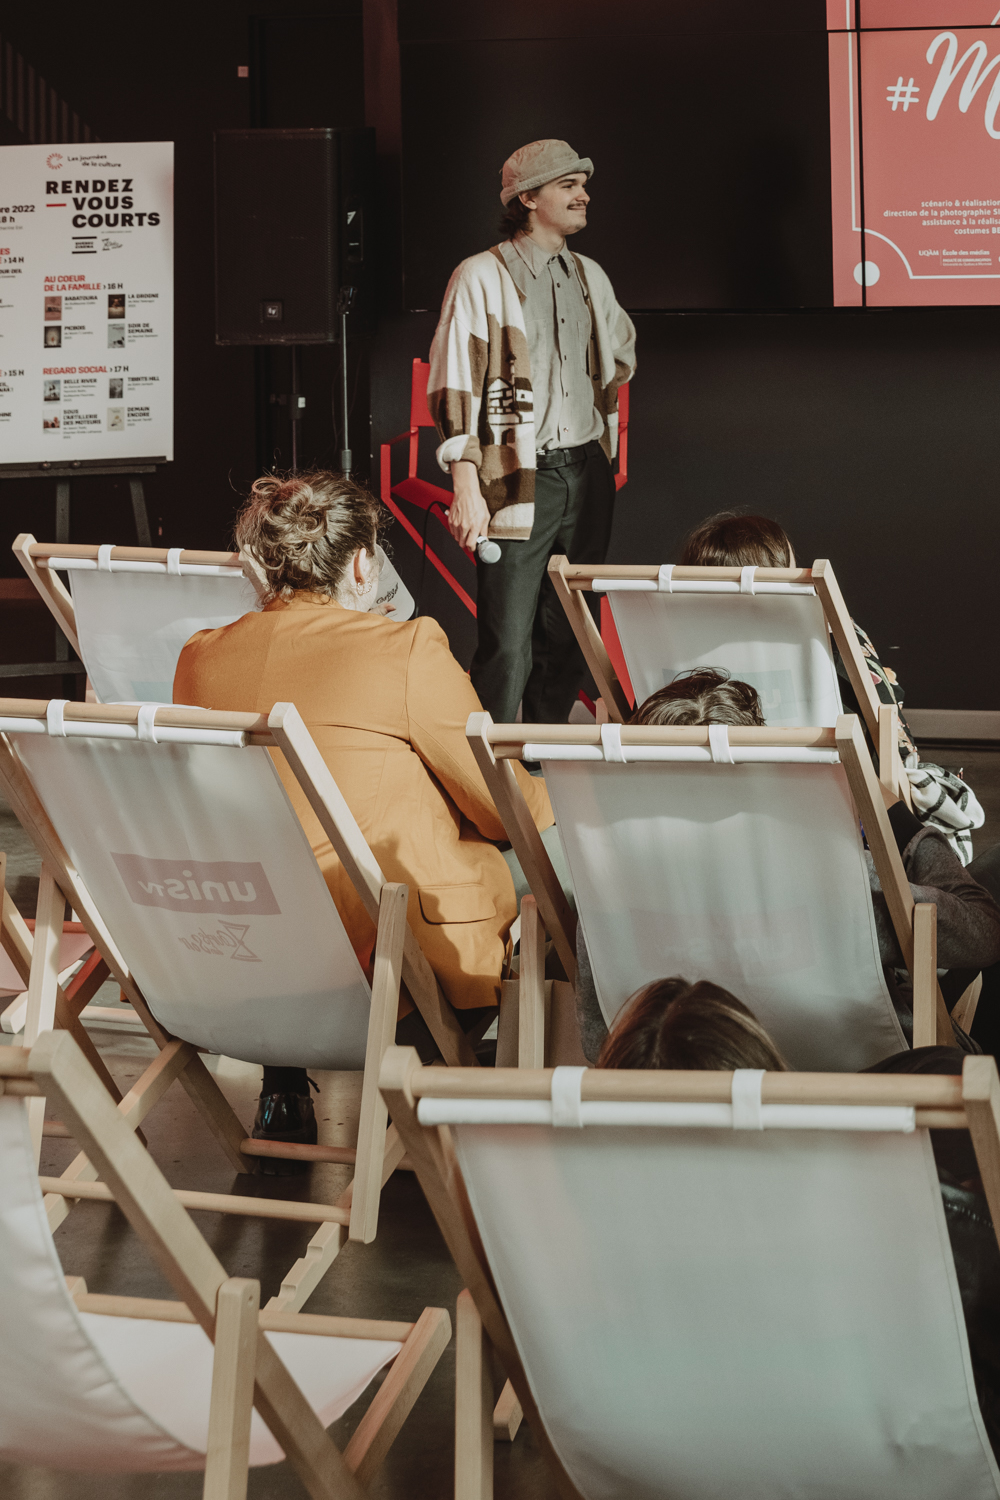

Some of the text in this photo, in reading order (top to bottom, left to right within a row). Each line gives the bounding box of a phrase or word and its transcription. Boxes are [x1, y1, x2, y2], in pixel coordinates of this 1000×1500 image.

[46, 179, 133, 194] RENDEZ
[72, 196, 134, 210] VOUS
[12, 205, 35, 213] 2022
[884, 209, 917, 217] direction
[919, 209, 929, 217] de
[940, 208, 991, 218] photographie
[72, 212, 160, 228] COURTS
[954, 227, 990, 235] costumes
[58, 275, 85, 283] COEUR
[57, 283, 67, 291] LA
